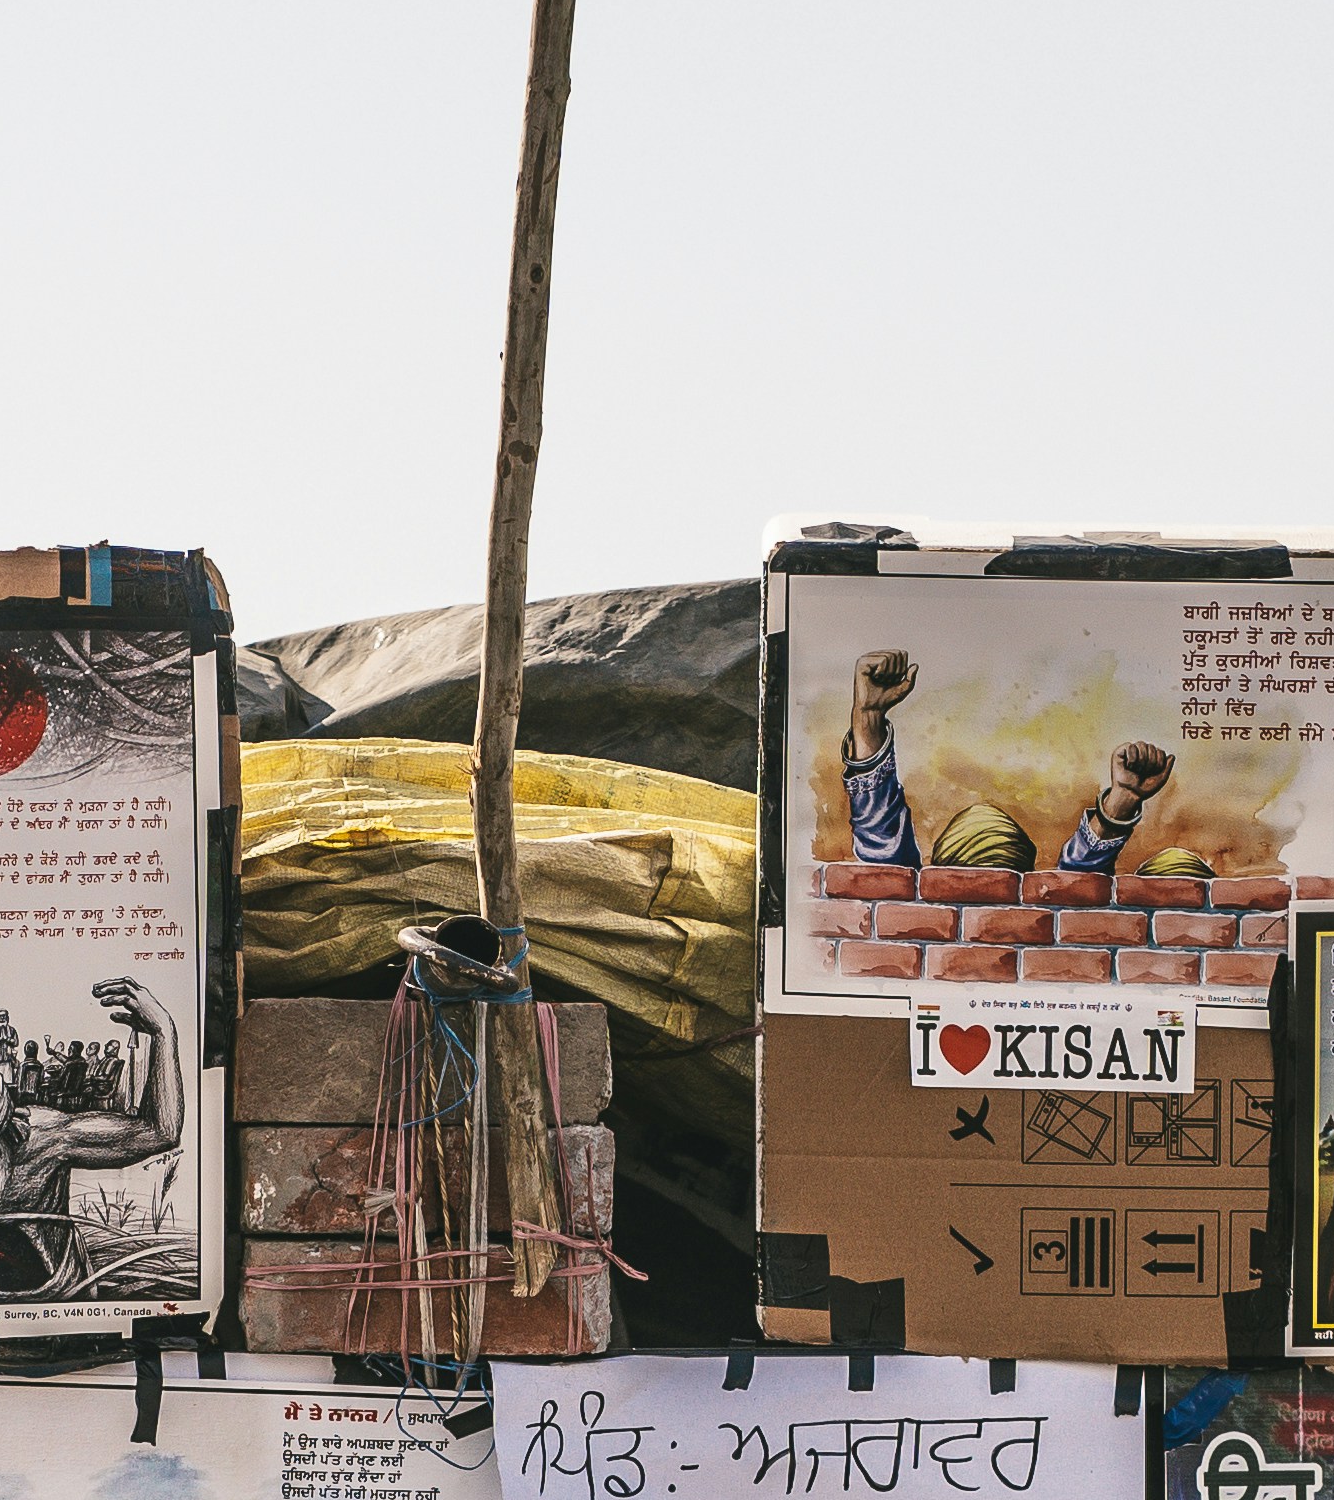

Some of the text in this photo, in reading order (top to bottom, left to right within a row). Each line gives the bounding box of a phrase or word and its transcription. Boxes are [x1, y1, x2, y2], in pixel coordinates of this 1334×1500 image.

[1183, 601, 1221, 620] ਬਾਗੀ
[1301, 603, 1319, 621] ਦੇ
[1183, 627, 1239, 650] ਹਕੂਮਤਾਂ
[1246, 627, 1263, 646] ਤੋਂ
[1270, 627, 1297, 645] ਗਏ
[994, 1022, 1185, 1083] KISAN
[43, 1308, 61, 1319] BC,
[113, 1307, 152, 1316] Canada
[309, 1404, 322, 1420] ਤੇ
[328, 1409, 377, 1422] ਨਾਨਕ
